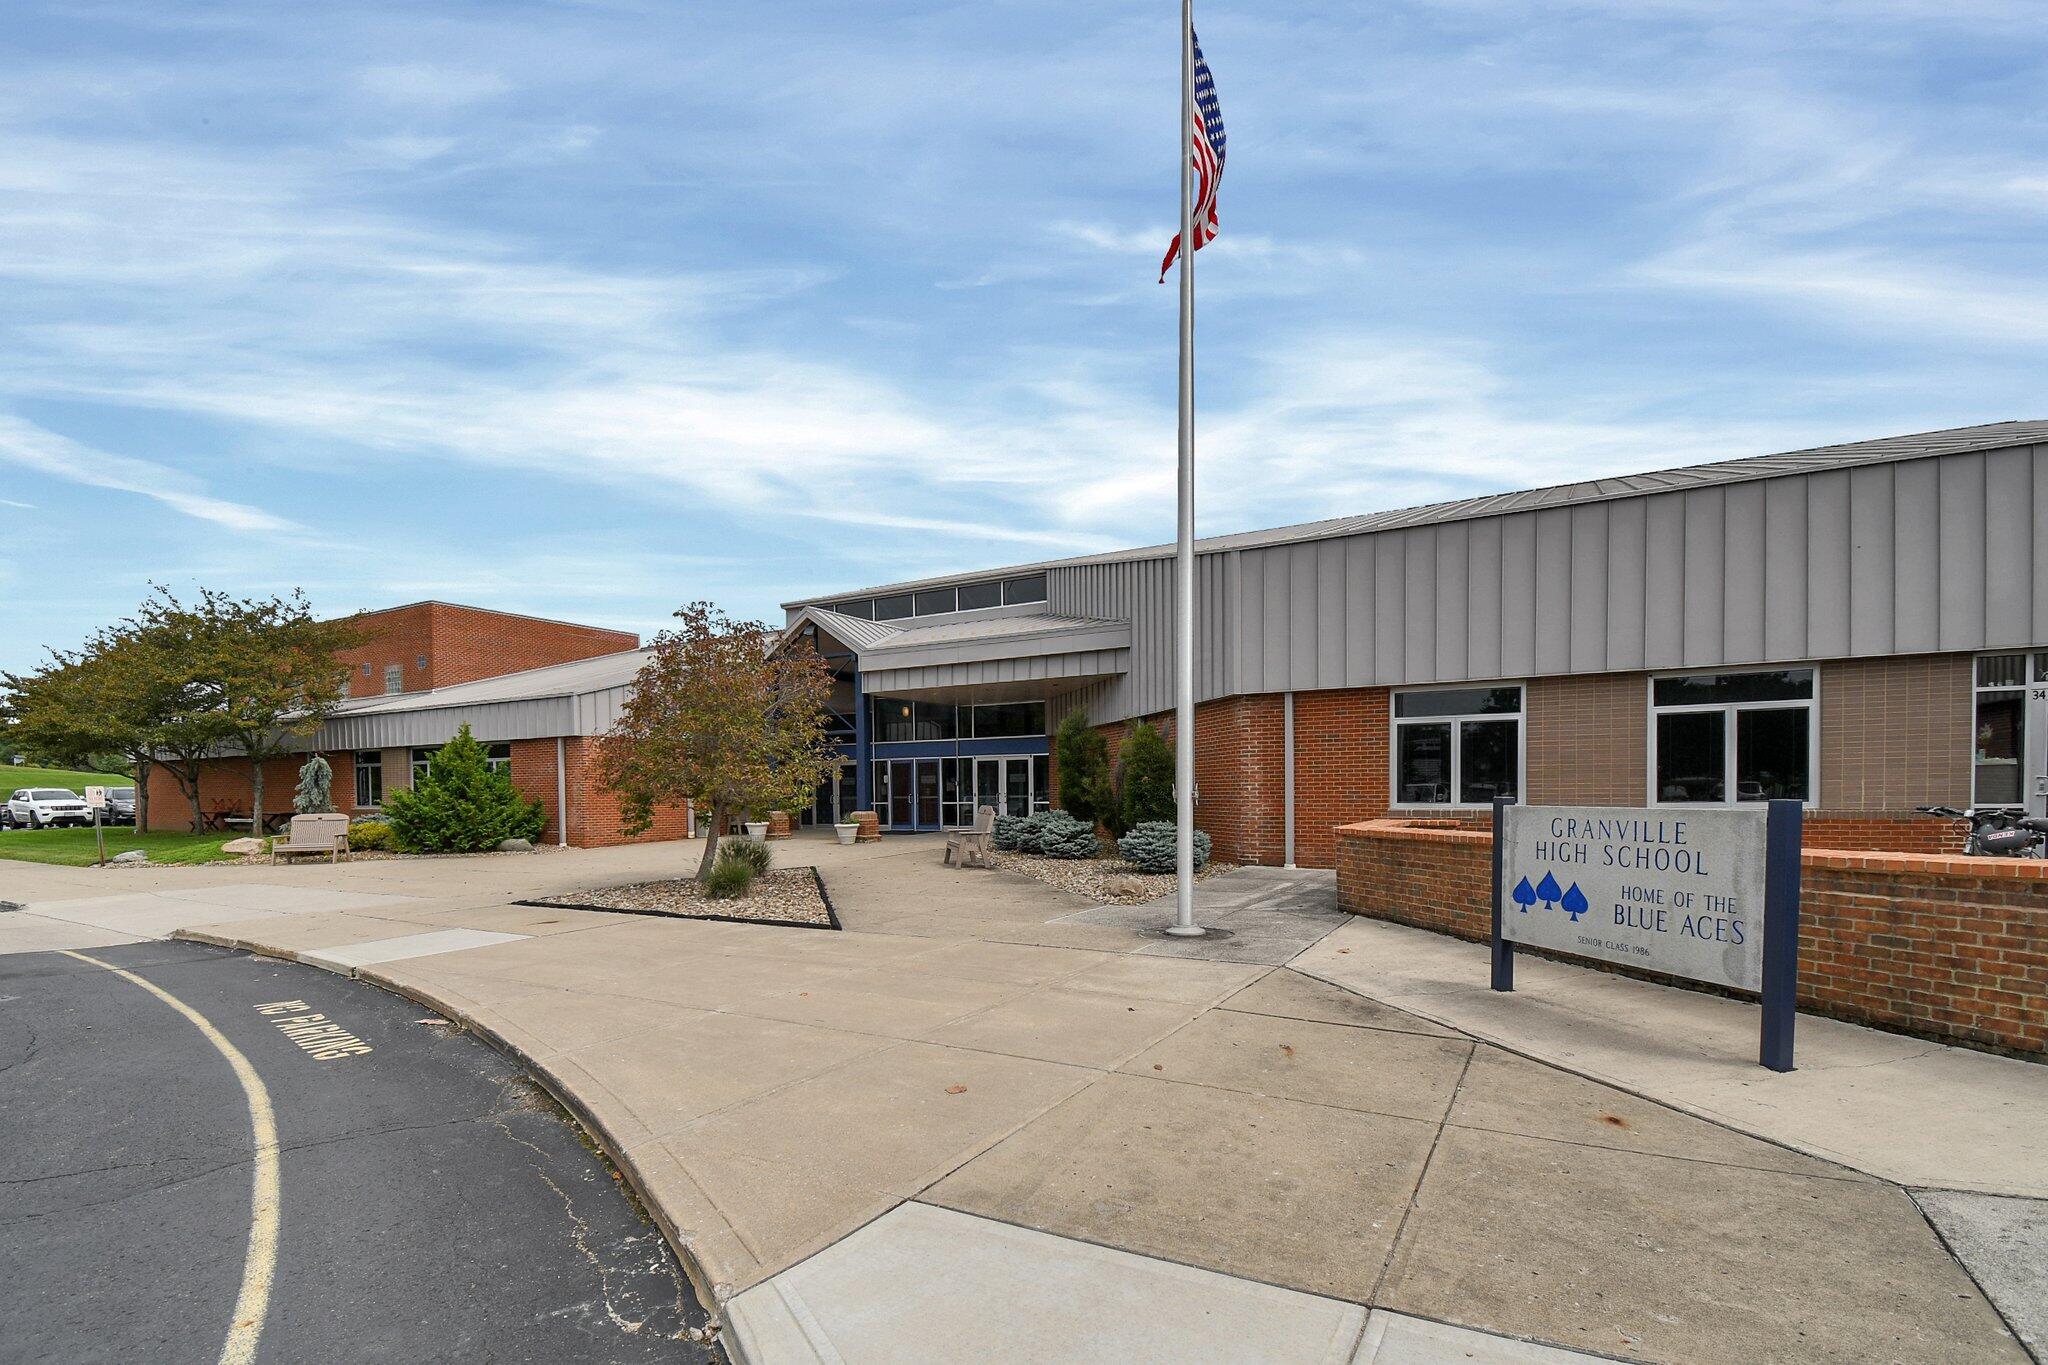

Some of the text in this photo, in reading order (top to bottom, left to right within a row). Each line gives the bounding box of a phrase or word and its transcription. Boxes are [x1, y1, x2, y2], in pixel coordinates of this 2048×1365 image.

[2033, 690, 2046, 700] 34
[1551, 817, 1688, 845] GRANVILLE
[1536, 841, 1709, 876] HIGH SCHOOL
[1621, 885, 1737, 914] HOME OF THE
[1614, 904, 1745, 945] BLUE ACES
[1577, 935, 1650, 957] SENIOR CLASS 1986
[253, 999, 373, 1060] NO PARKING
